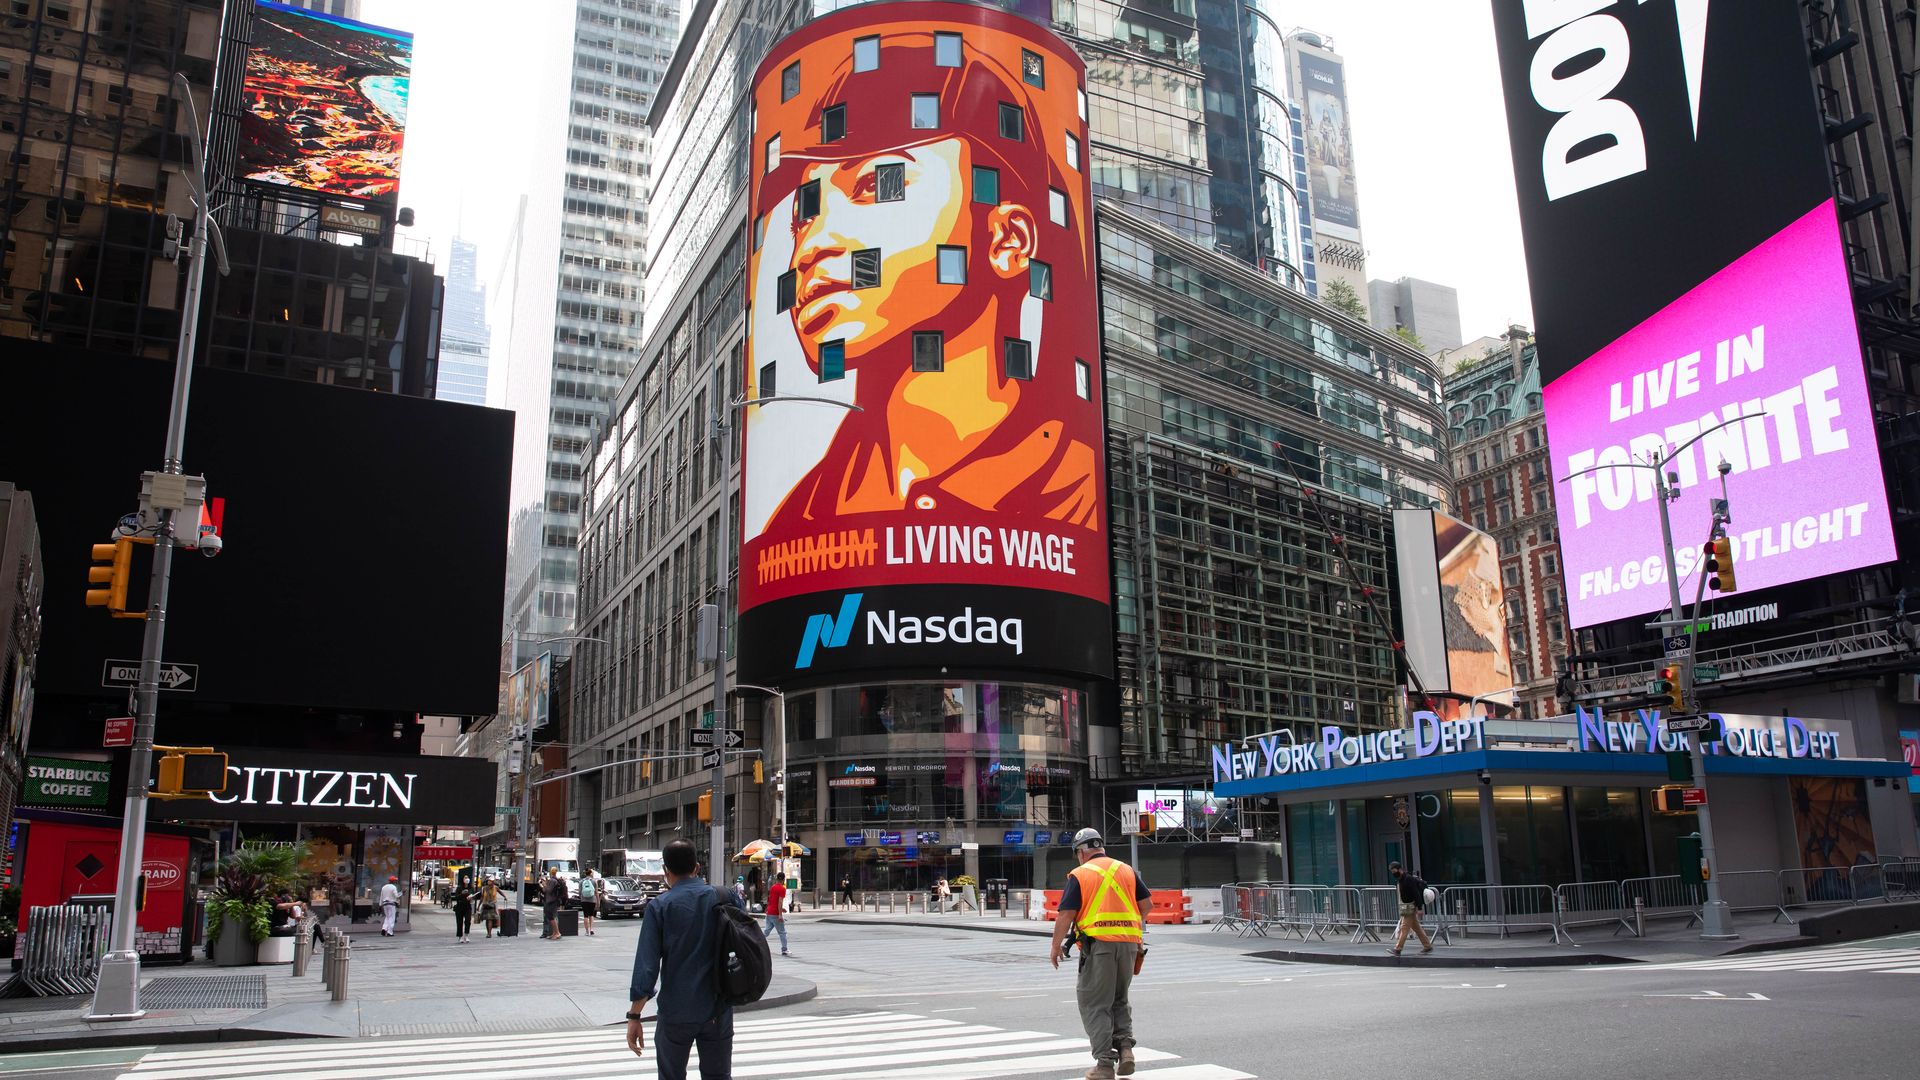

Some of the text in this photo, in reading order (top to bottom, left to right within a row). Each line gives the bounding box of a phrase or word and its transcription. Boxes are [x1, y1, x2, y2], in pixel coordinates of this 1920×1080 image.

[1522, 0, 1647, 202] DO
[1610, 324, 1765, 423] LIVE IN
[1567, 365, 1850, 530] FORTNITE
[758, 525, 1077, 586] MINIMUM LIVING WAGE
[867, 607, 1023, 656] Nasdaq
[1695, 668, 1718, 679] Broadway
[1575, 703, 1638, 754] NEW
[1782, 716, 1840, 760] DEPT
[1670, 718, 1704, 730] ONE WAY
[725, 735, 737, 743] AY
[1212, 710, 1489, 783] NEW YORK POLICE DEPT
[28, 765, 109, 783] STARBUCKS
[854, 765, 876, 773] Nasdaq
[1000, 764, 1021, 773] Nasdaq
[40, 782, 92, 797] COFFEE
[207, 765, 418, 809] CITIZEN
[889, 803, 920, 813] Nasdaq
[1164, 799, 1177, 811] up
[1094, 920, 1133, 928] CONTRACTOR
